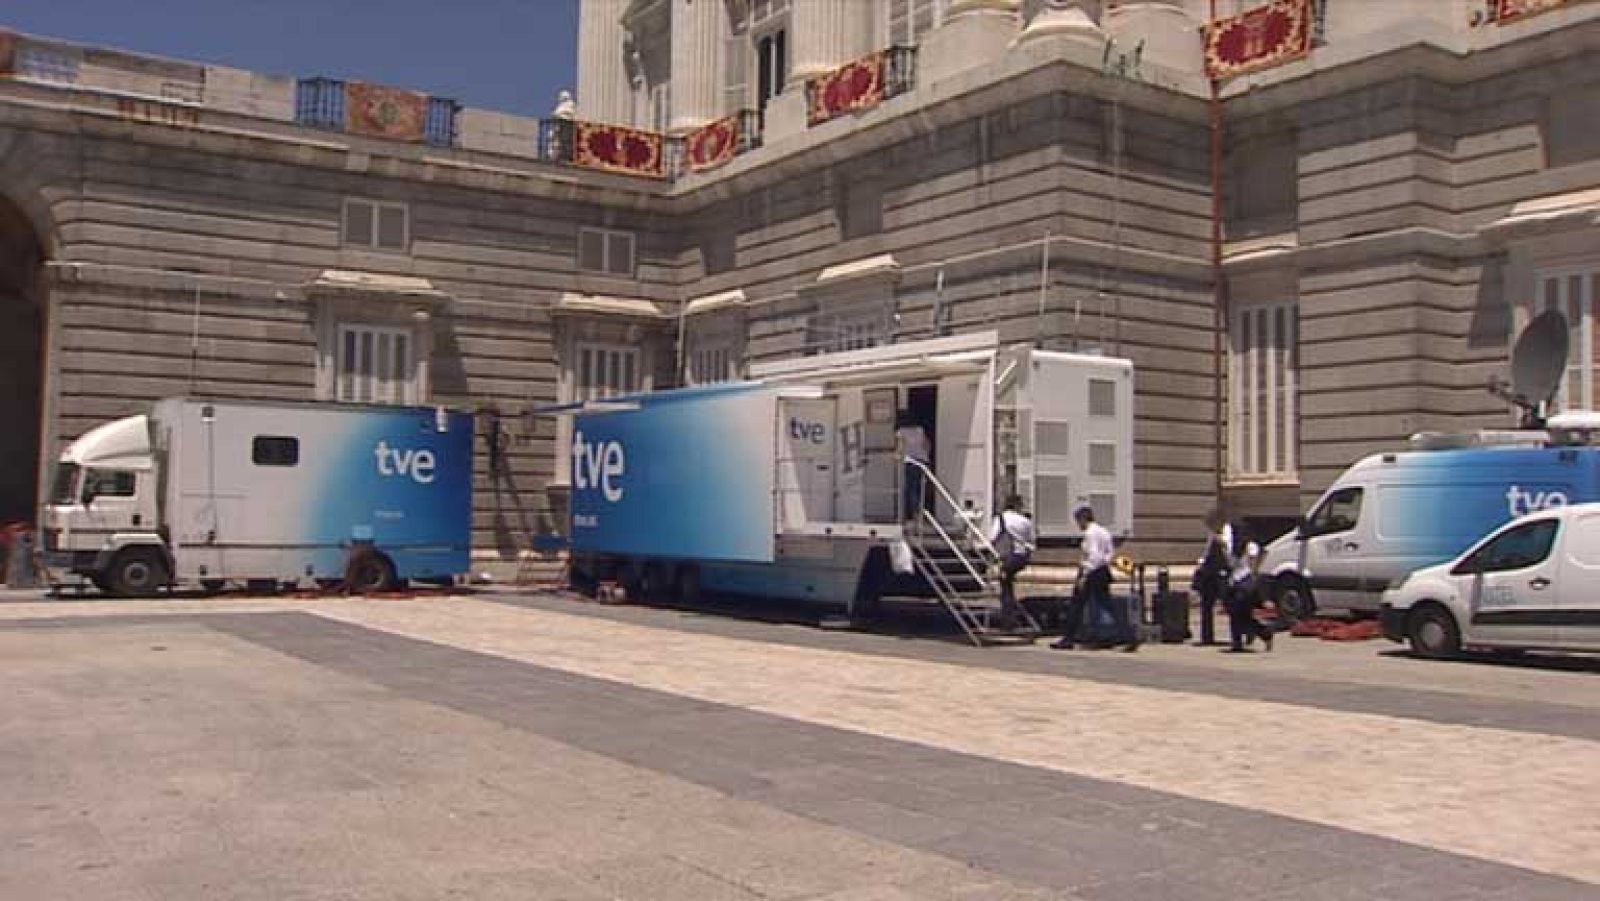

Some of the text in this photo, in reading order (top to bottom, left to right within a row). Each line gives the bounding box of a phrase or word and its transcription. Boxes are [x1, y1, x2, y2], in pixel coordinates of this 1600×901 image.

[788, 416, 825, 444] tve
[375, 441, 436, 482] tve
[573, 431, 624, 501] tve
